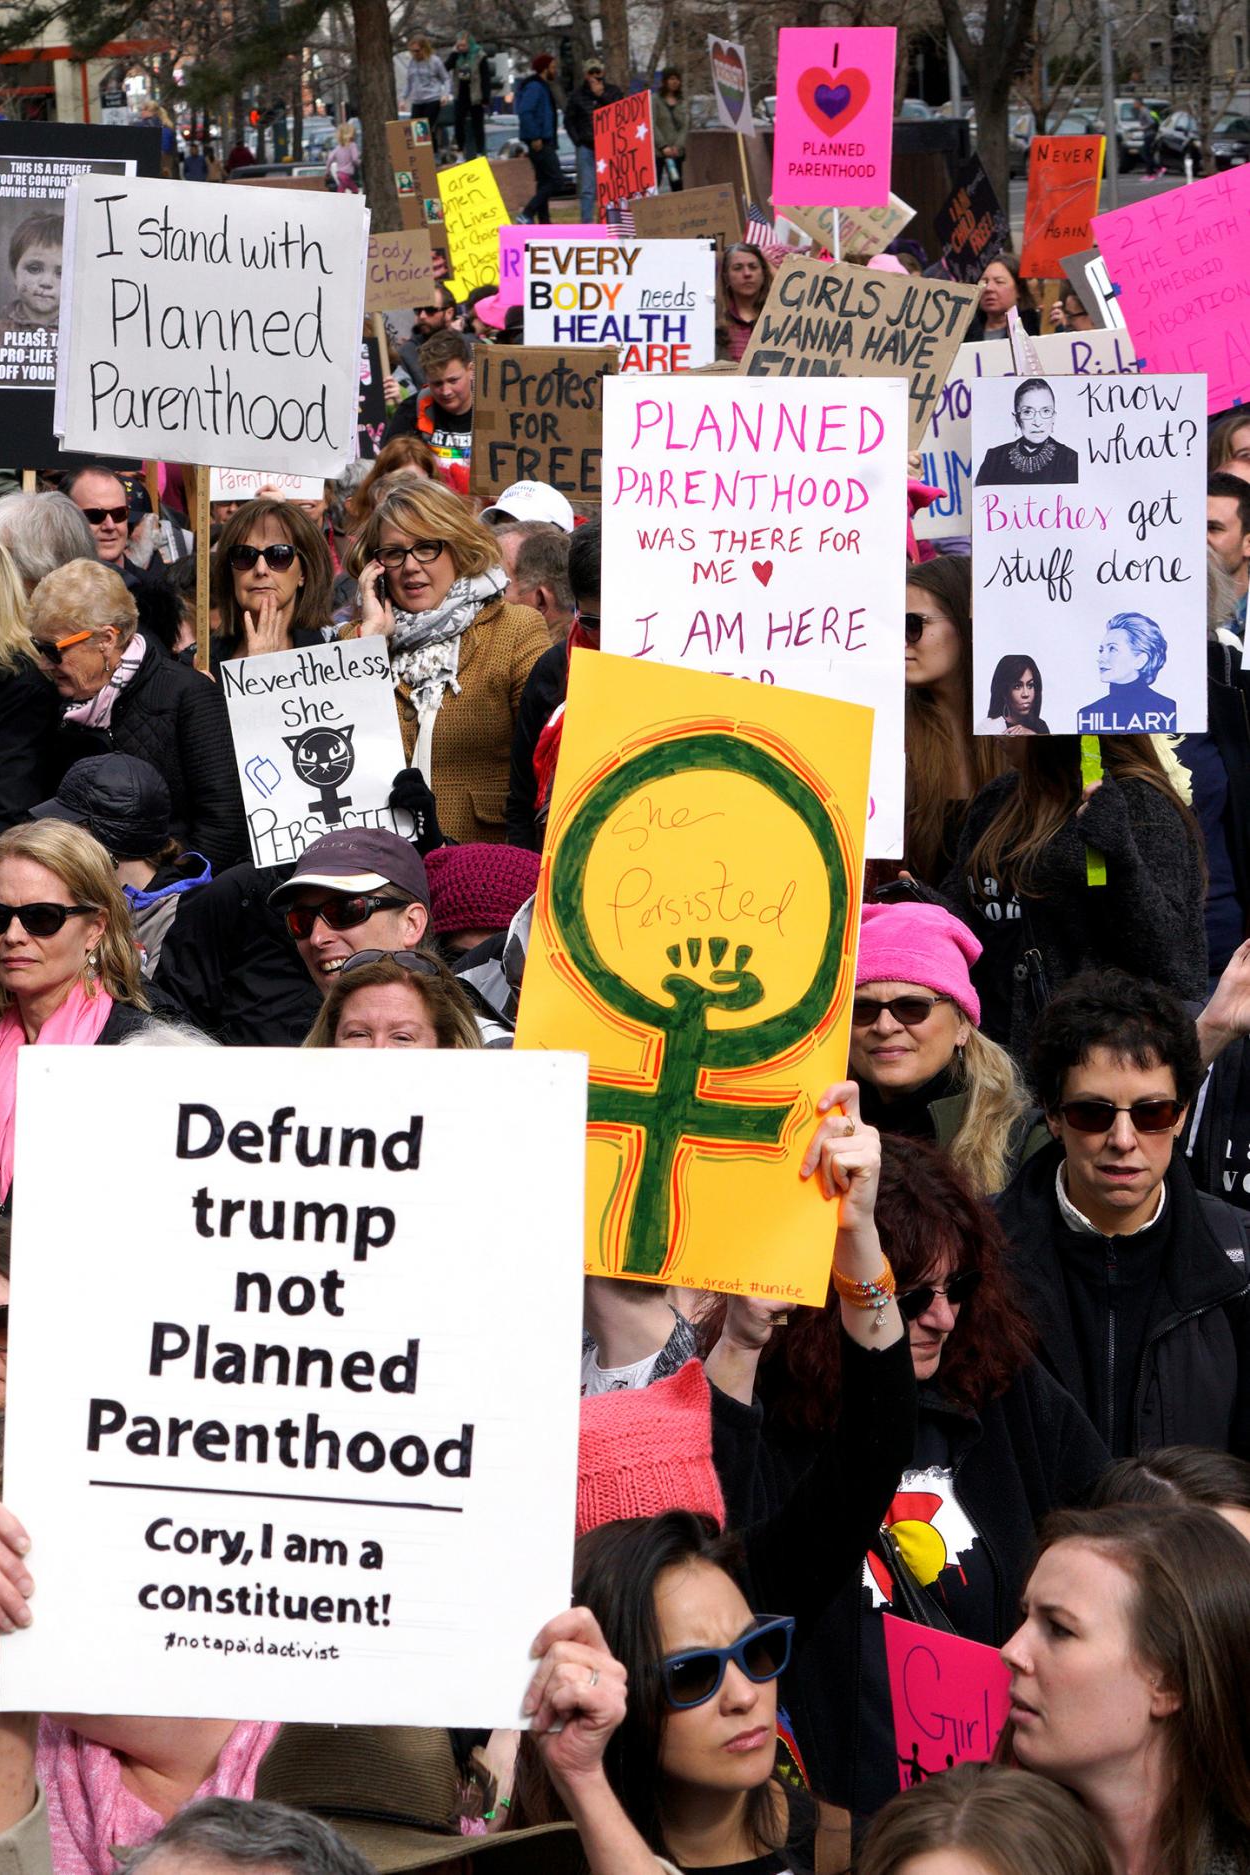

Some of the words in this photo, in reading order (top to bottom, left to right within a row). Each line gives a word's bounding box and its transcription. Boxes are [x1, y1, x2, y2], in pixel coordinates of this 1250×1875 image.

[832, 43, 839, 68] I
[595, 107, 610, 136] MY
[615, 96, 647, 128] BODY
[612, 127, 628, 155] IS
[803, 142, 865, 157] PLANNED
[1037, 144, 1093, 164] NEVER
[11, 163, 33, 173] THIS
[34, 163, 43, 173] IS
[44, 163, 52, 174] A
[448, 172, 481, 192] are
[609, 149, 638, 180] NOT
[789, 163, 876, 178] PARENTHOOD
[29, 187, 47, 198] HER
[94, 194, 128, 258] I
[138, 205, 232, 264] stand
[240, 221, 333, 274] with
[459, 207, 498, 229] Lives
[1044, 220, 1090, 239] AGAIN
[1177, 216, 1240, 256] EARTH
[371, 263, 432, 283] Choice
[530, 246, 641, 276] EVERY
[530, 281, 624, 311] BODY
[640, 281, 697, 309] needs
[1138, 256, 1224, 308] SPHEROID
[111, 278, 333, 363] Planned
[779, 270, 885, 320] GIRLS
[886, 285, 973, 337] JUST
[4, 332, 49, 346] PLEASE
[554, 314, 687, 343] HEALTH
[761, 314, 854, 359] WANNA
[861, 325, 939, 369] HAVE
[0, 349, 53, 365] PRO-LIFE
[22, 365, 55, 380] YOUR
[606, 343, 691, 372] ARE
[482, 358, 489, 398] I
[90, 361, 338, 450] Parenthood
[509, 412, 561, 444] FOR
[631, 400, 885, 455] PLANNED
[1088, 419, 1198, 466] what?
[488, 441, 602, 492] FREE
[613, 466, 869, 514] PARENTHOOD
[980, 493, 1113, 532] Bitches
[1128, 490, 1182, 541] get
[637, 527, 696, 552] WAS
[709, 527, 803, 554] THERE
[819, 527, 860, 554] FOR
[693, 560, 737, 585] ME
[984, 547, 1075, 603] stuff
[1096, 549, 1192, 585] done
[631, 612, 659, 657] I
[680, 610, 745, 657] AM
[767, 606, 867, 651] HERE
[222, 645, 390, 698] Nevertheless,
[281, 696, 344, 728] She
[1078, 712, 1176, 731] HILLARY
[607, 861, 798, 951] Persisted
[175, 1101, 424, 1172] Defund
[191, 1186, 396, 1261] trump
[234, 1268, 346, 1317] not
[681, 1275, 696, 1287] us
[749, 1281, 806, 1299] #unite
[148, 1321, 420, 1395] Planned
[86, 1398, 475, 1479] Parenthood
[144, 1517, 254, 1565] Cory,
[260, 1522, 273, 1560] I
[284, 1533, 347, 1568] am
[358, 1538, 384, 1570] a
[137, 1578, 392, 1628] constituent!
[904, 1645, 992, 1757] Girl
